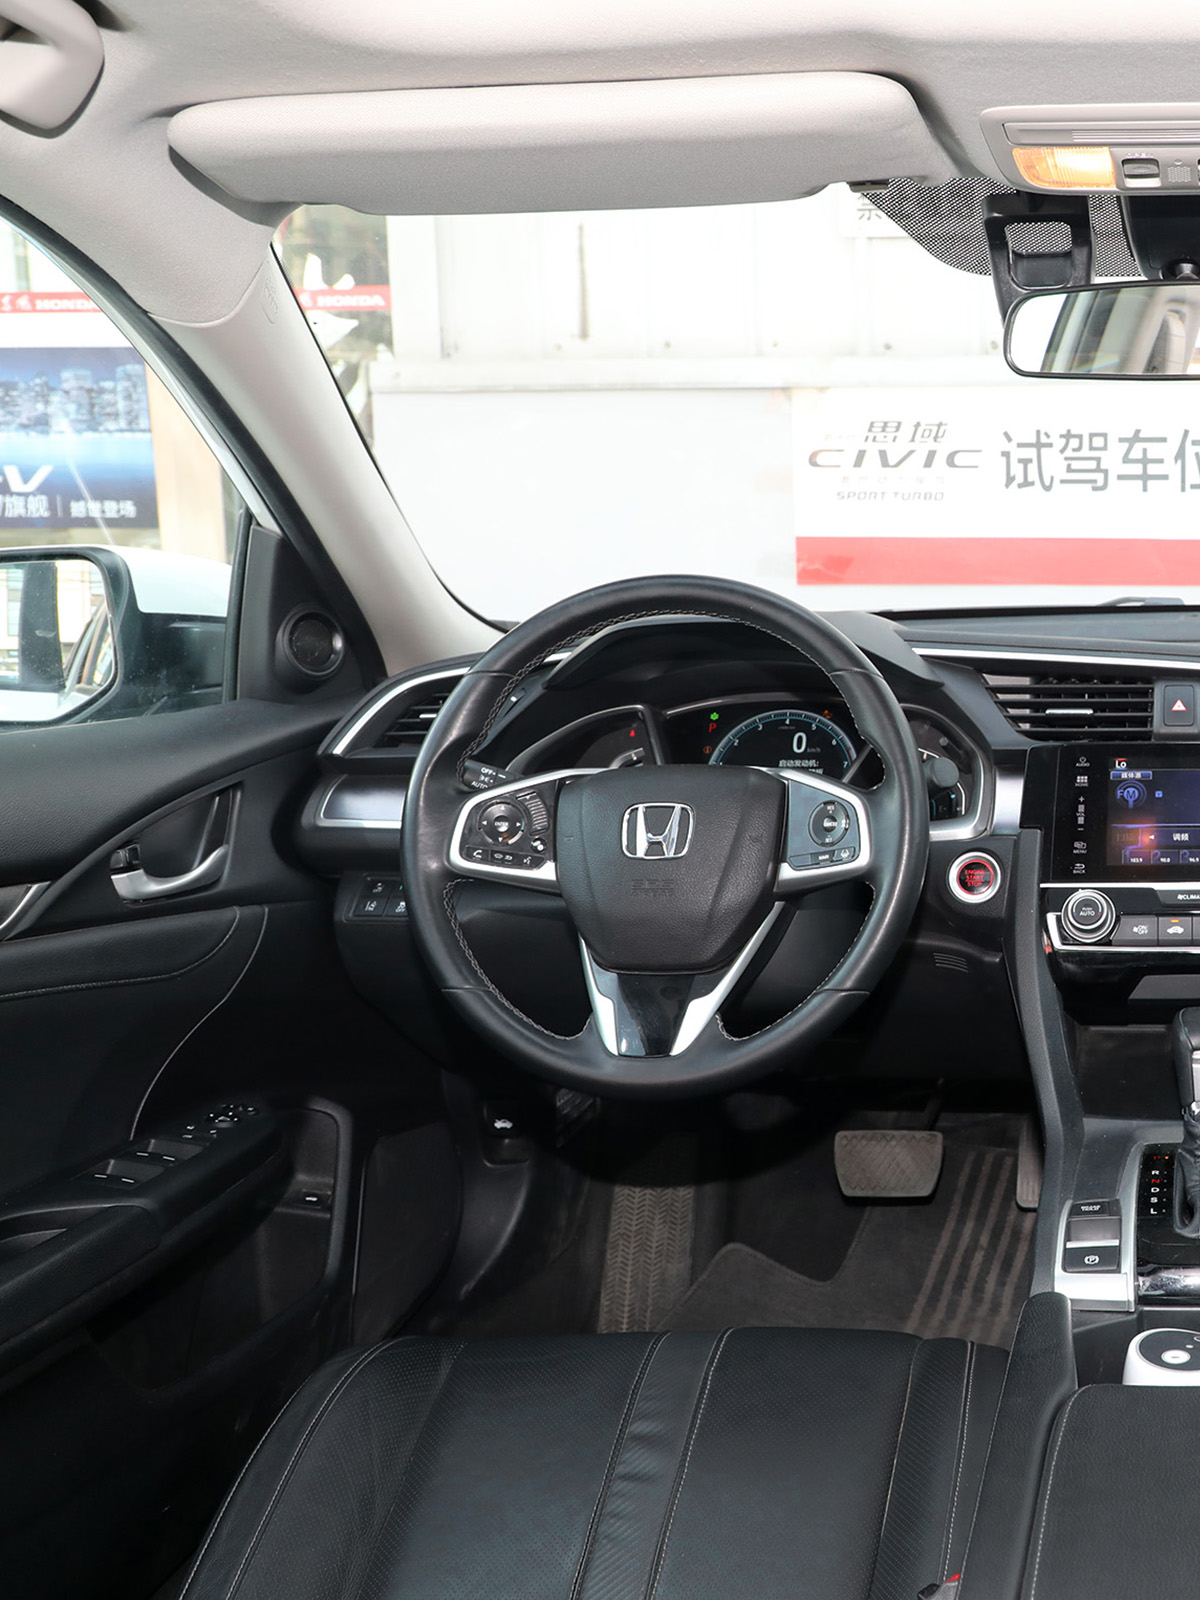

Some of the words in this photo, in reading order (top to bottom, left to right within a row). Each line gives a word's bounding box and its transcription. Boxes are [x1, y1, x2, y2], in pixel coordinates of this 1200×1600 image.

[317, 295, 386, 307] HONDA
[864, 421, 948, 443] 思域
[808, 449, 983, 468] CIVIC
[836, 491, 888, 501] SPORT
[891, 491, 945, 501] TURBO
[0, 493, 51, 519] 旗舰
[708, 722, 717, 733] P
[793, 732, 807, 754] 0
[481, 767, 493, 775] OFF
